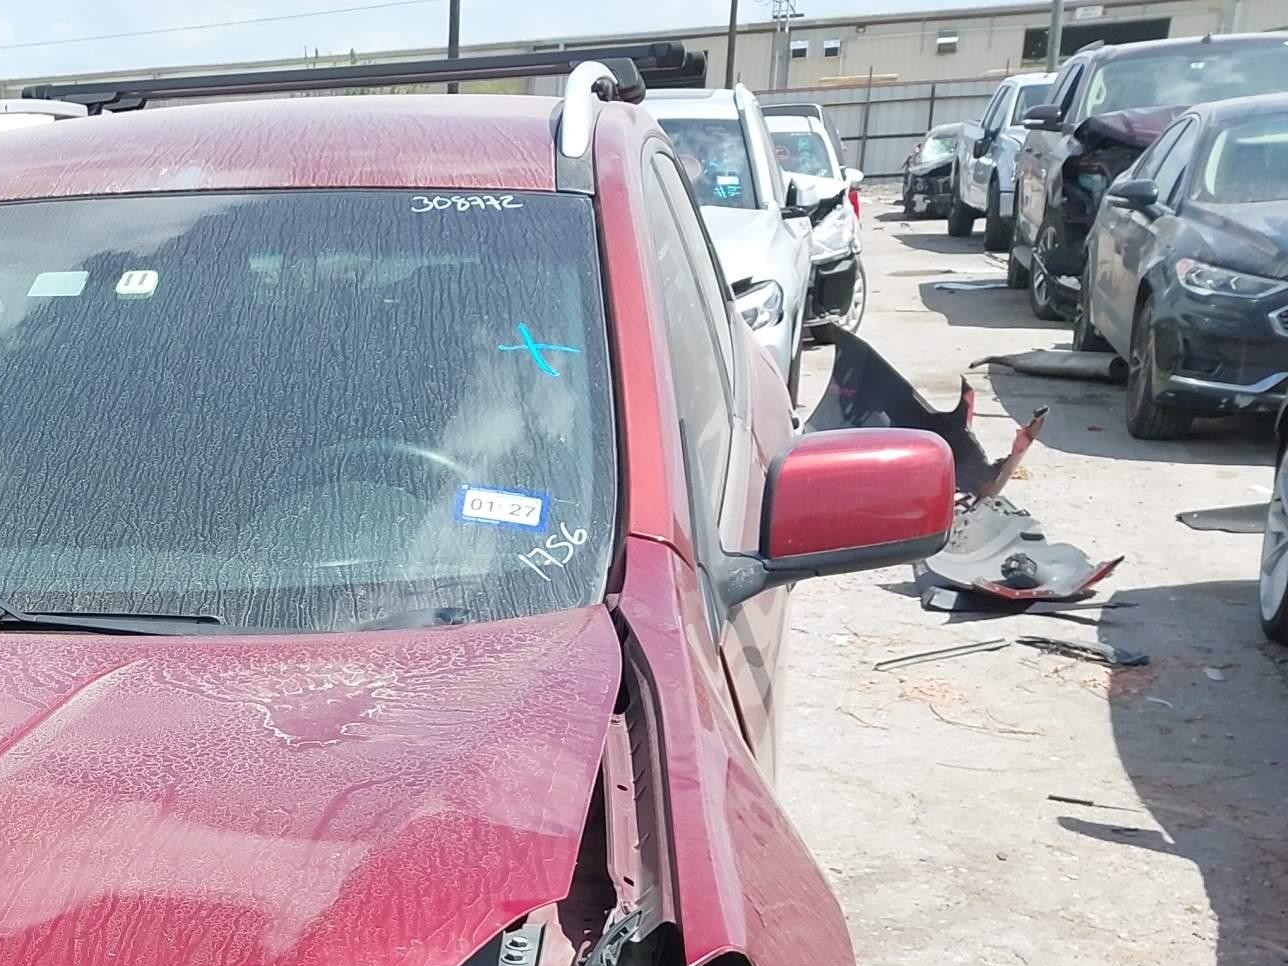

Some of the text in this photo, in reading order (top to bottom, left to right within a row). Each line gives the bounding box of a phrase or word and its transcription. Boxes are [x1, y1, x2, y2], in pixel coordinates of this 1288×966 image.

[411, 195, 524, 213] 308772
[470, 498, 536, 517] 01 27
